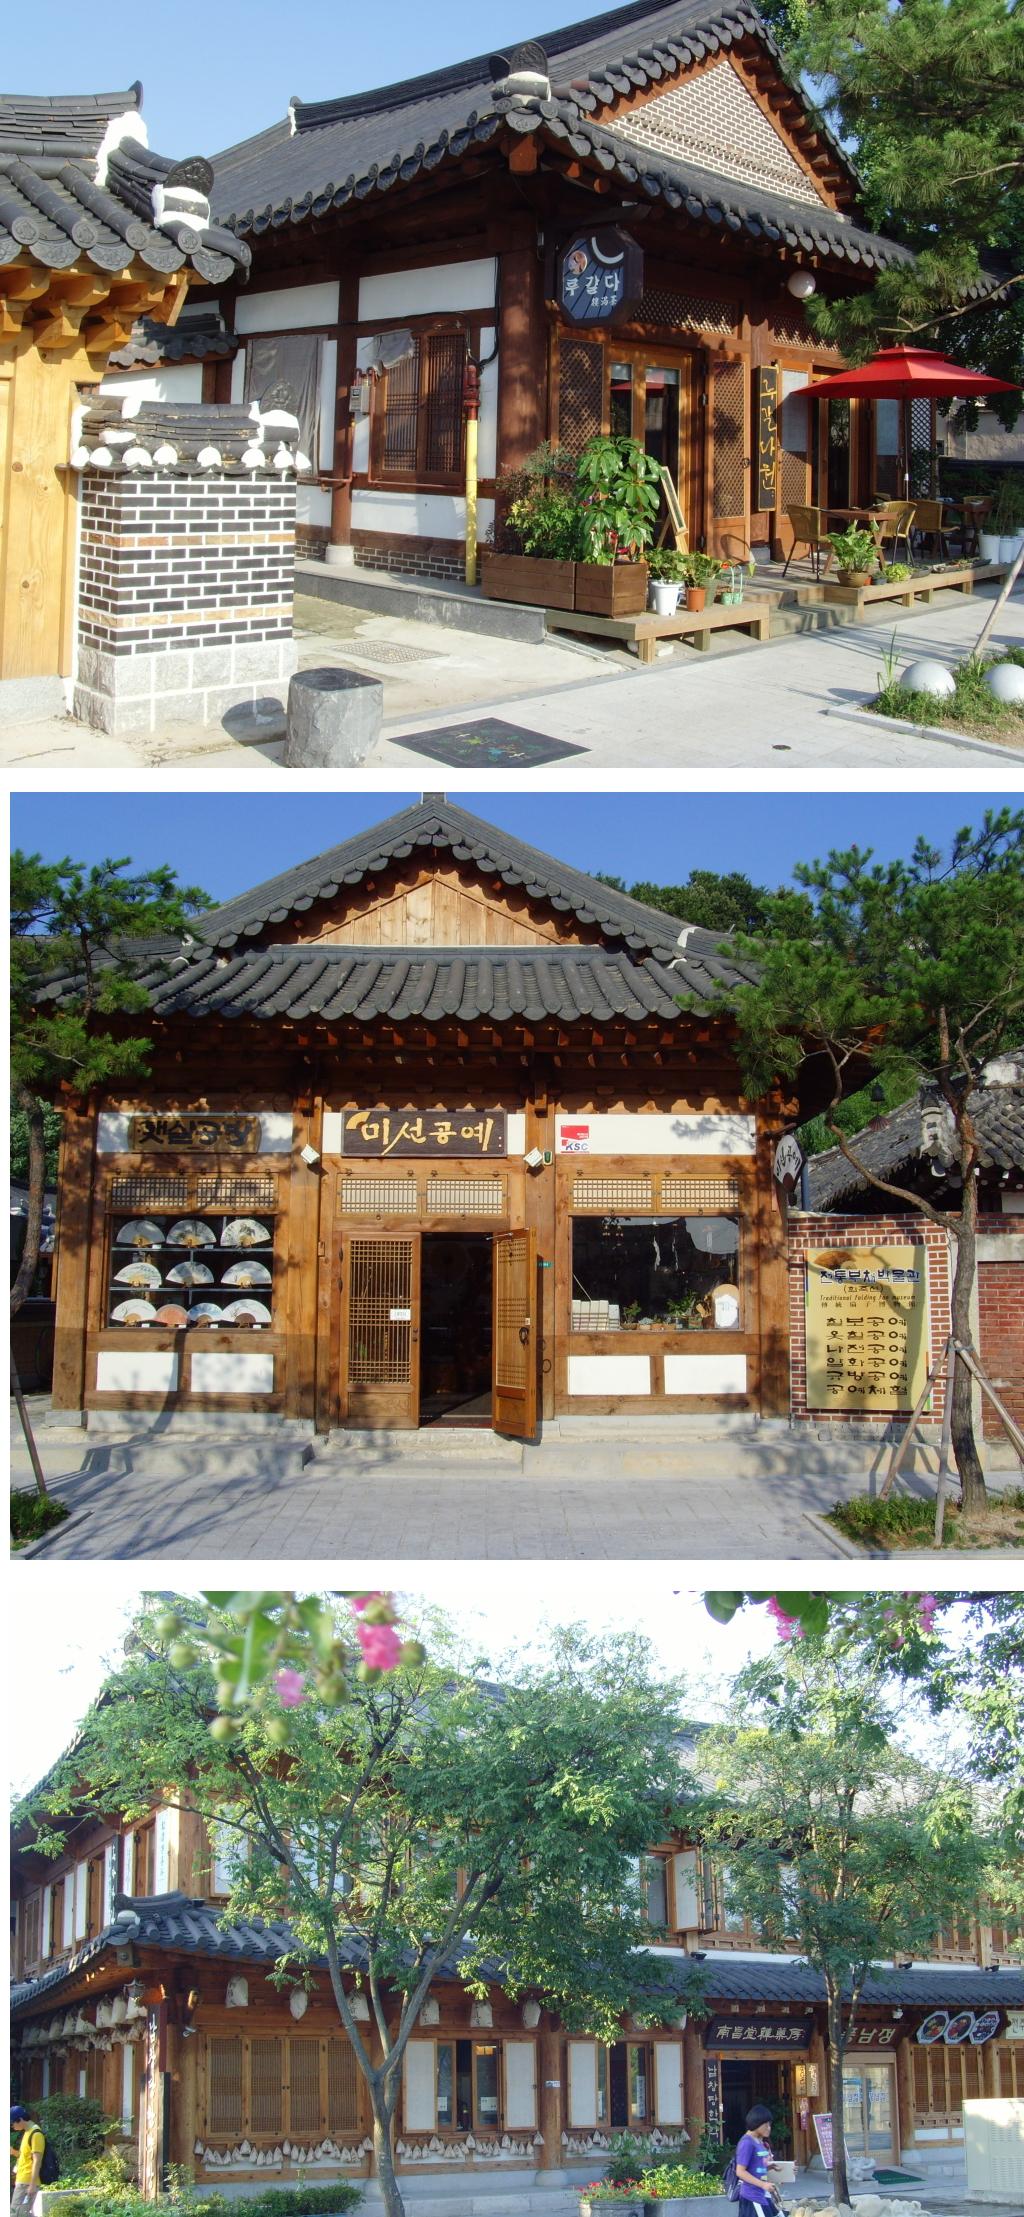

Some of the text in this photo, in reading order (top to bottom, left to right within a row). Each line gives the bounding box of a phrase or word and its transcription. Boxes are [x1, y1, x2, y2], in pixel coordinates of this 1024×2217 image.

[565, 272, 620, 296] 루갈다
[361, 1117, 494, 1156] 미선공예
[565, 1142, 589, 1151] KSC
[820, 1268, 920, 1284] 전통부채박물관
[826, 1343, 908, 1354] 나전공예
[826, 1384, 908, 1396] 공예체험
